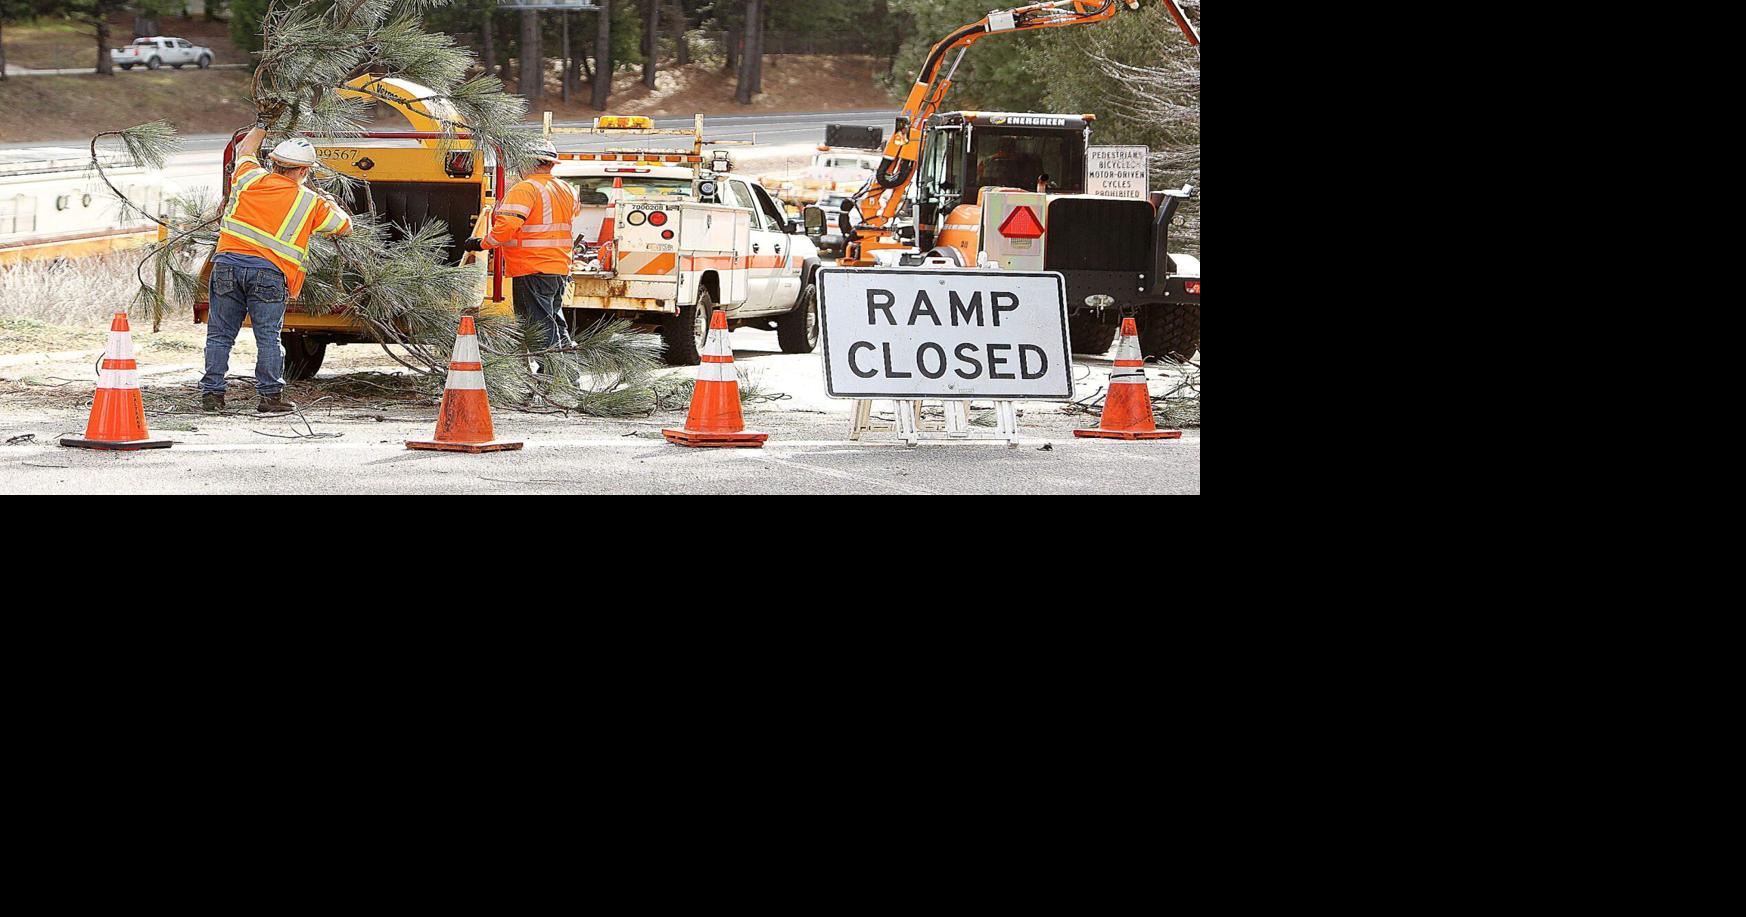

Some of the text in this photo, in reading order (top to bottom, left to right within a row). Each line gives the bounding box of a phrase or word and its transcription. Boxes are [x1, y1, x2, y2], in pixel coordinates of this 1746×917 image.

[1006, 116, 1066, 126] ENERGREEN
[1089, 170, 1145, 179] MOTOR-DRIVEN
[1102, 180, 1131, 188] CYCLES
[866, 288, 1020, 327] RAMP
[847, 340, 1049, 380] CLOSED
